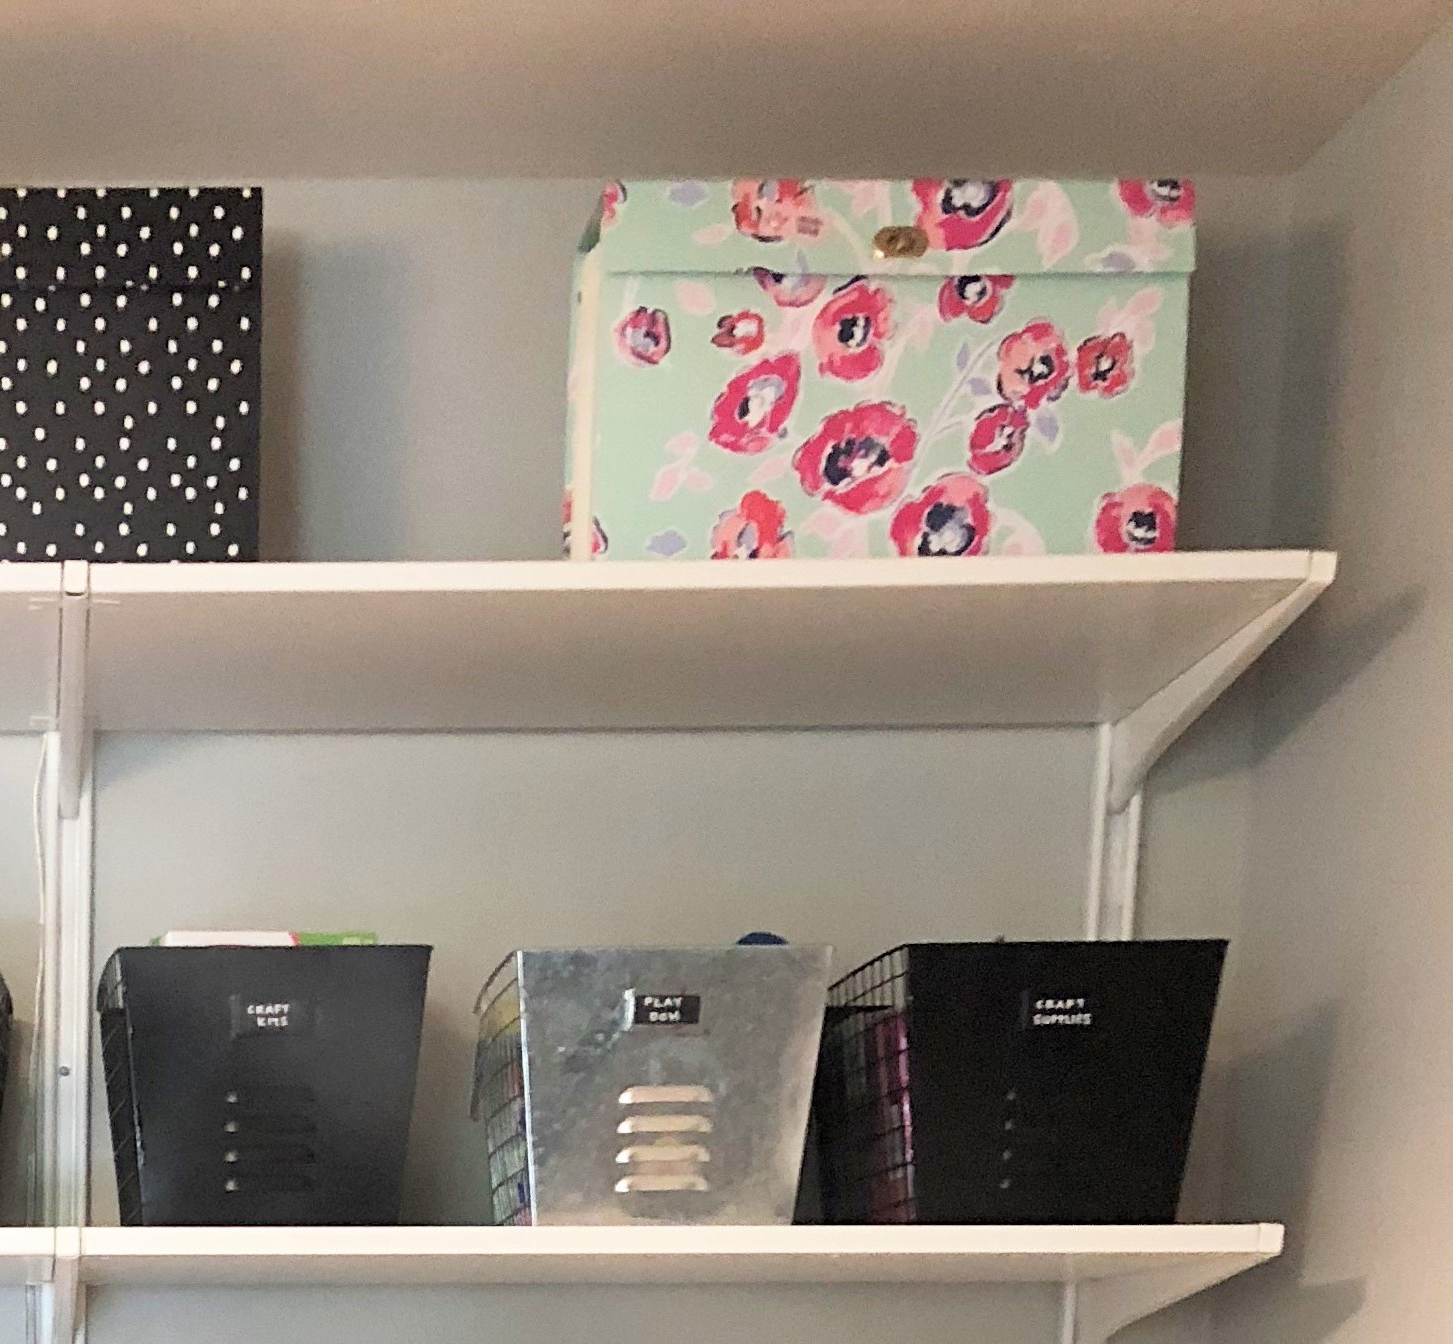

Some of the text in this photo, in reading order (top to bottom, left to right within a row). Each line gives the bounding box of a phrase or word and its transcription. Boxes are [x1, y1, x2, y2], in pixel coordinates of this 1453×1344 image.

[644, 997, 683, 1008] PLAY
[1035, 998, 1085, 1010] CRAFT
[247, 1003, 290, 1015] CRAFT
